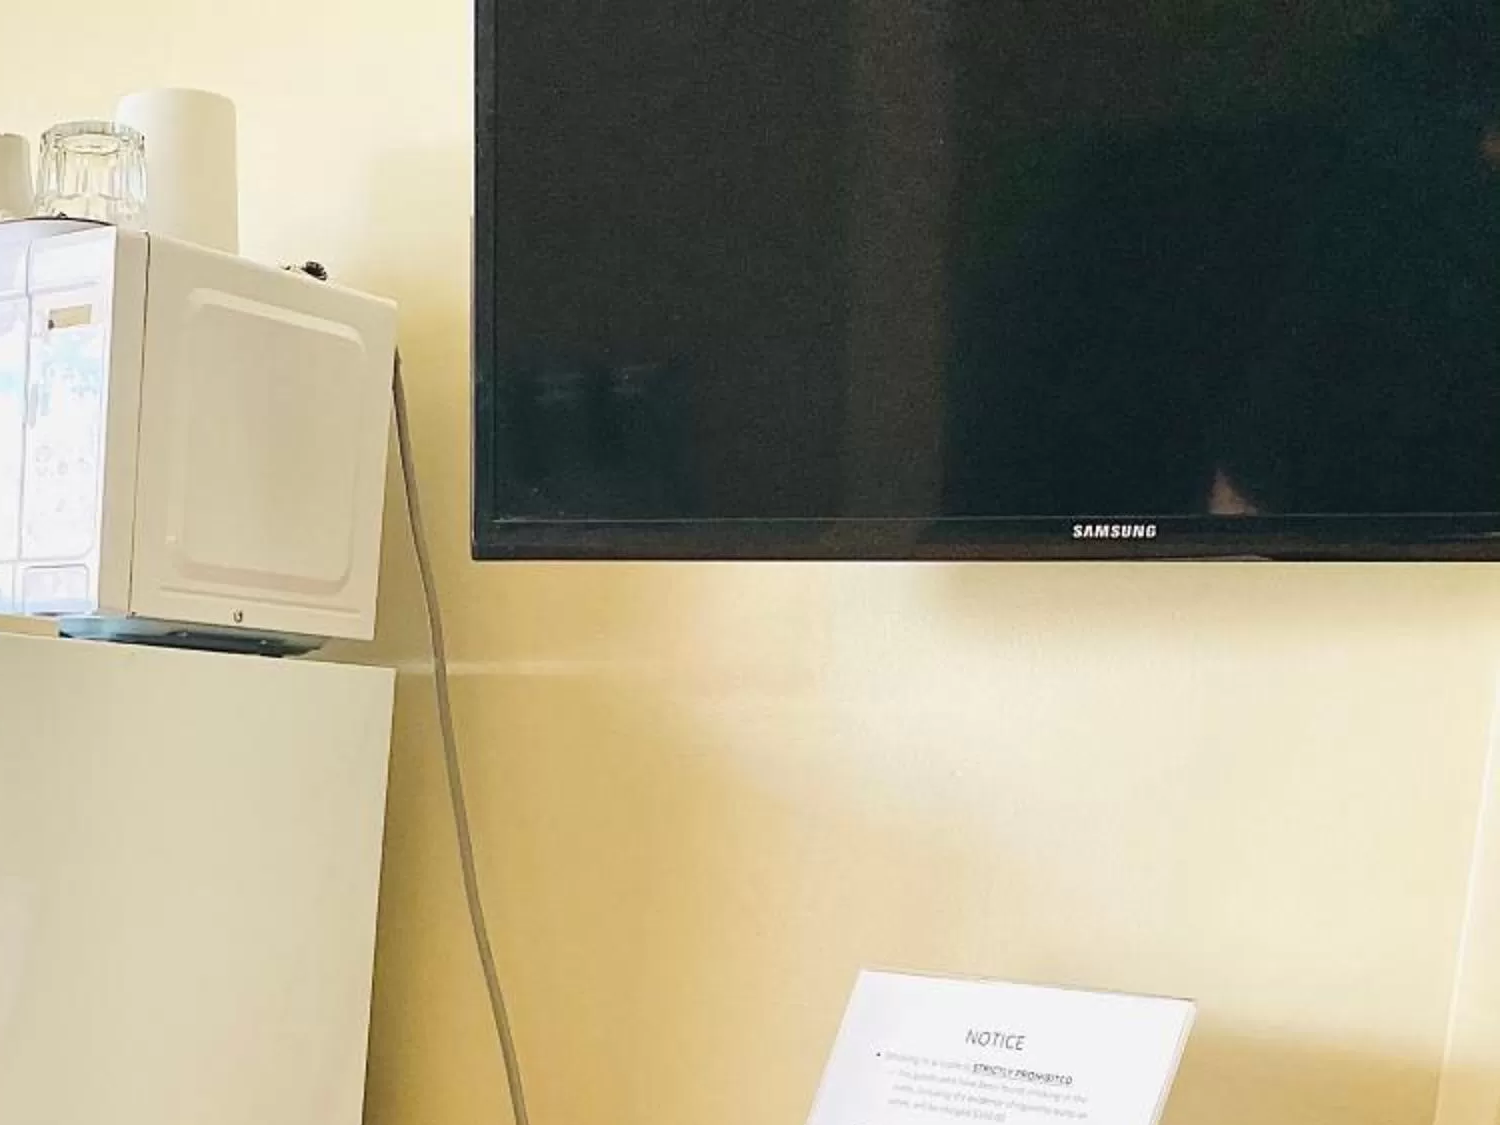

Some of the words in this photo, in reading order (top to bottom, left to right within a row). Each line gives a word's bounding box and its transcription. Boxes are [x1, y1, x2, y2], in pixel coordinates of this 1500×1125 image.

[1073, 524, 1157, 538] SAMSUNG
[965, 1029, 1026, 1051] NOTICE
[1012, 1067, 1073, 1086] PROHIBITED
